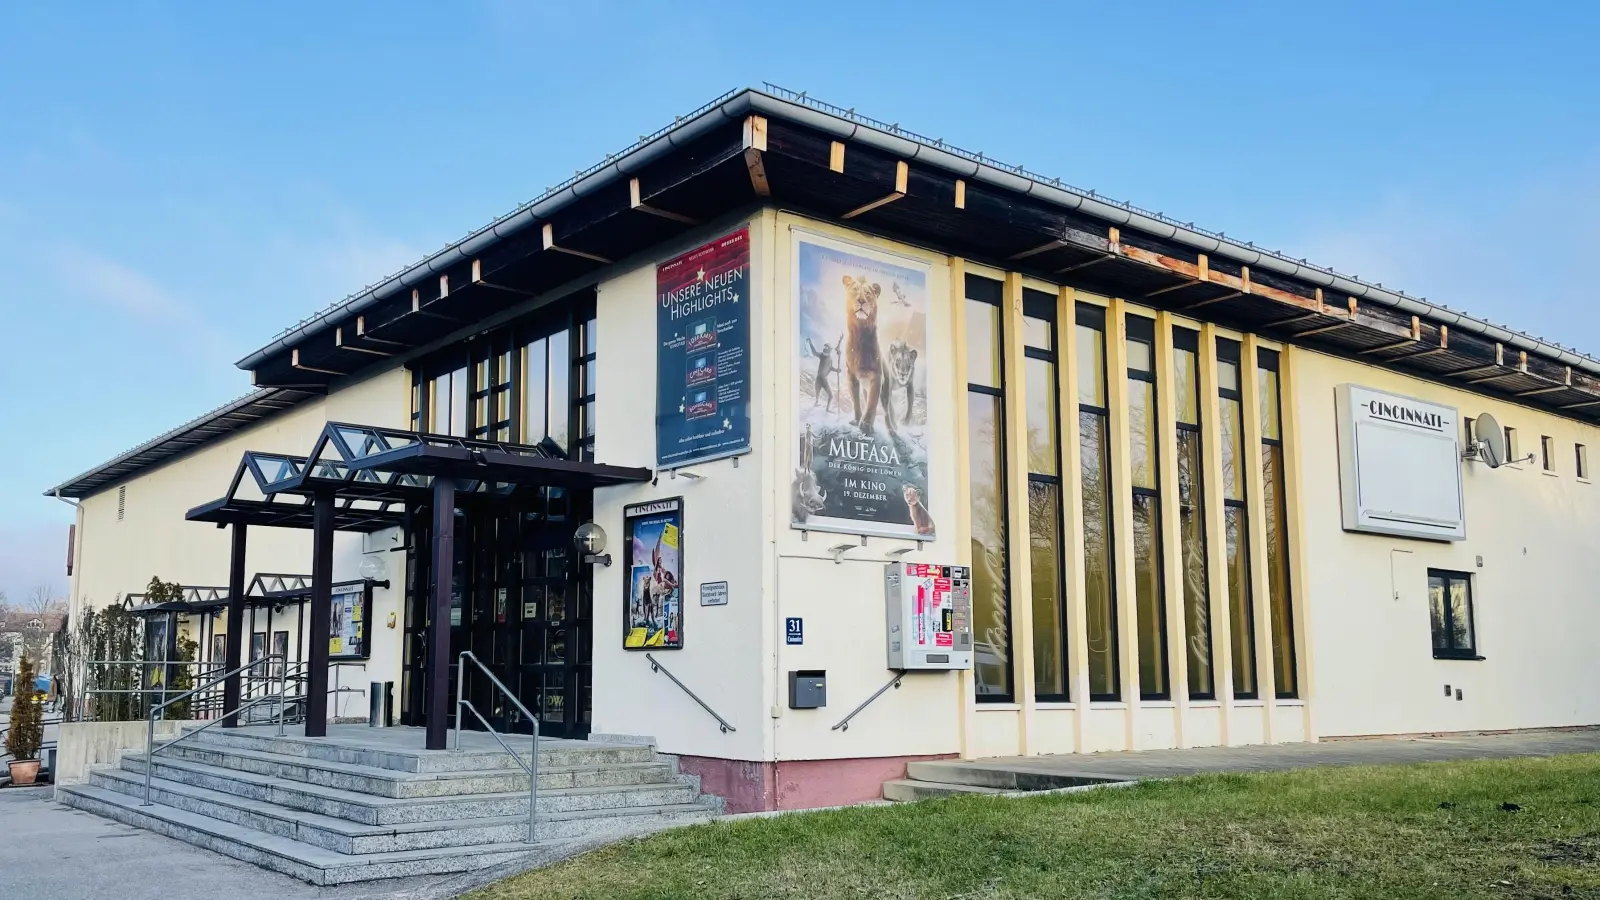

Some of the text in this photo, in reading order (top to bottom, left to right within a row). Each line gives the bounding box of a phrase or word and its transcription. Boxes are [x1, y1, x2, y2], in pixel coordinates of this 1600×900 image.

[662, 265, 743, 308] UNSERE NEUEN
[670, 286, 733, 321] HIGHLIGHTS
[1369, 400, 1442, 428] CINCINNATI
[828, 437, 901, 466] MUFASA
[828, 461, 841, 469] DER
[843, 463, 865, 473] KÖNIG
[880, 468, 902, 477] LÖWEN
[843, 490, 888, 501] 19. DEZEMBER
[844, 478, 887, 492] IM KINO
[984, 521, 1009, 664] Coca-C
[1187, 532, 1209, 666] Coca-Cl
[788, 619, 801, 632] 31
